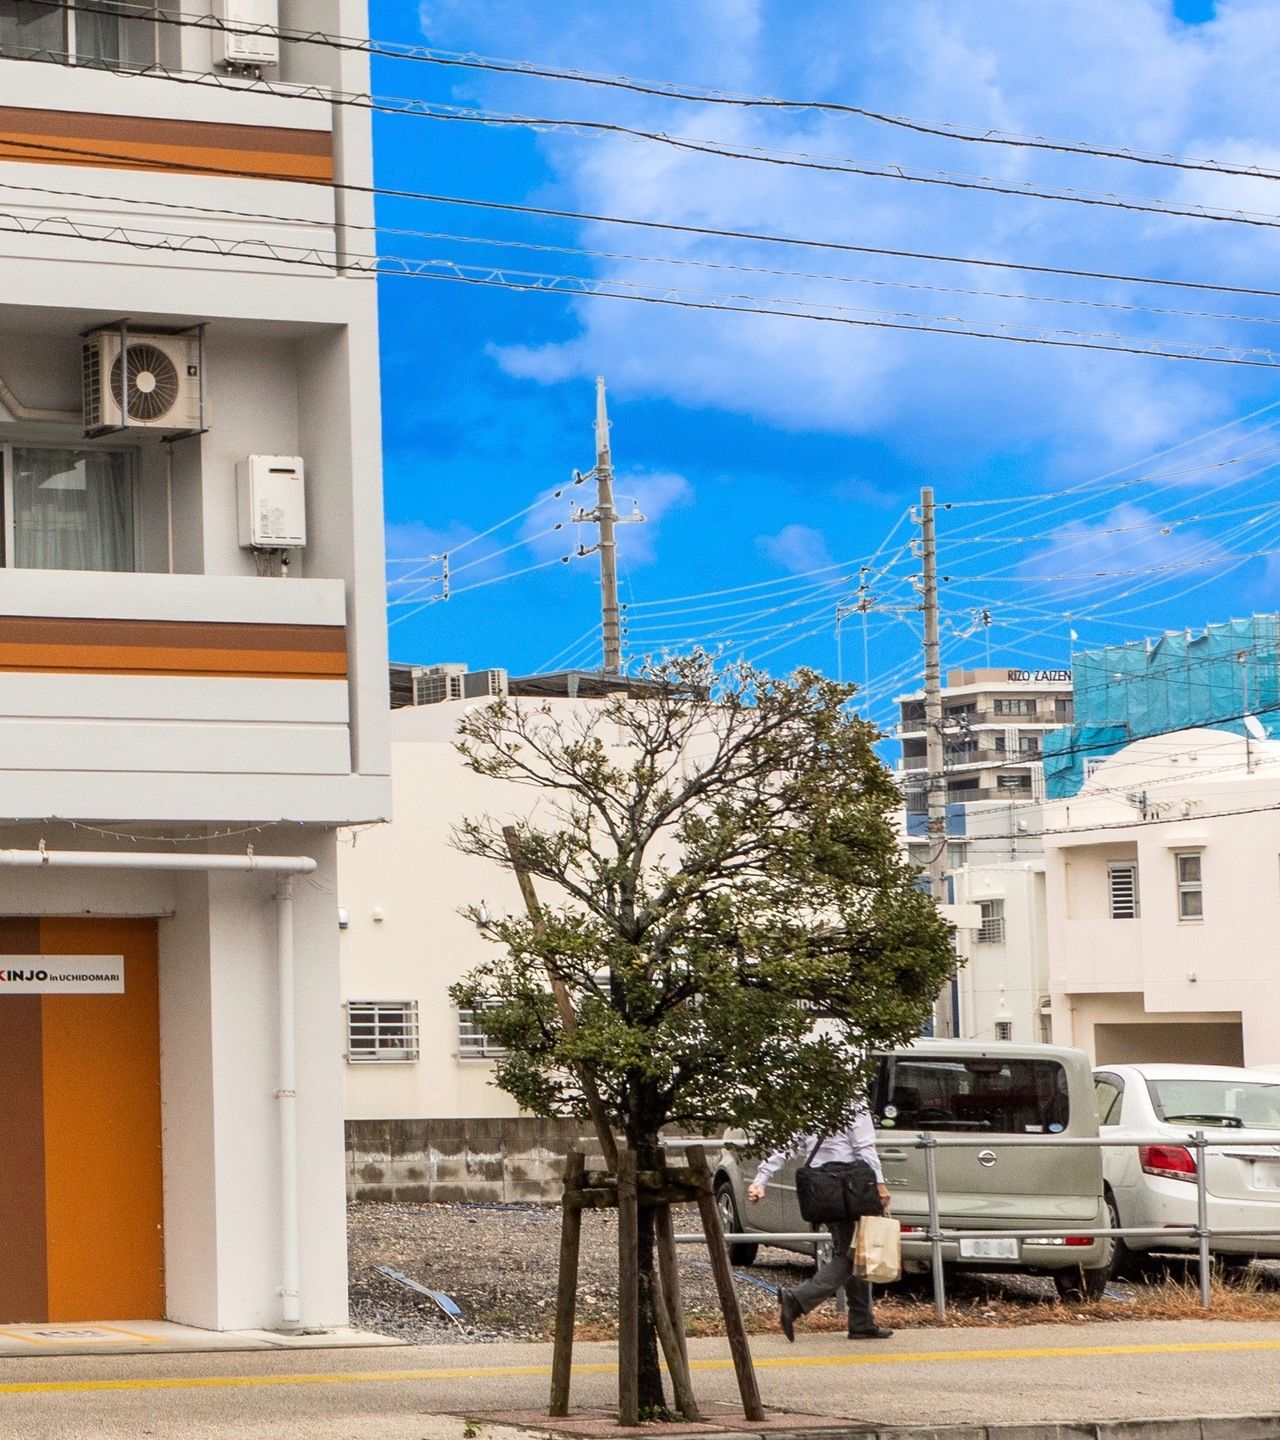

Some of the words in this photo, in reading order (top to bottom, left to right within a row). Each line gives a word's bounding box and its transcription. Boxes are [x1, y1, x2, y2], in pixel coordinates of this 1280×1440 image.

[1007, 669, 1030, 681] RIZO
[1034, 669, 1072, 681] ZAIZEN
[59, 974, 120, 982] UCHIDOMARI
